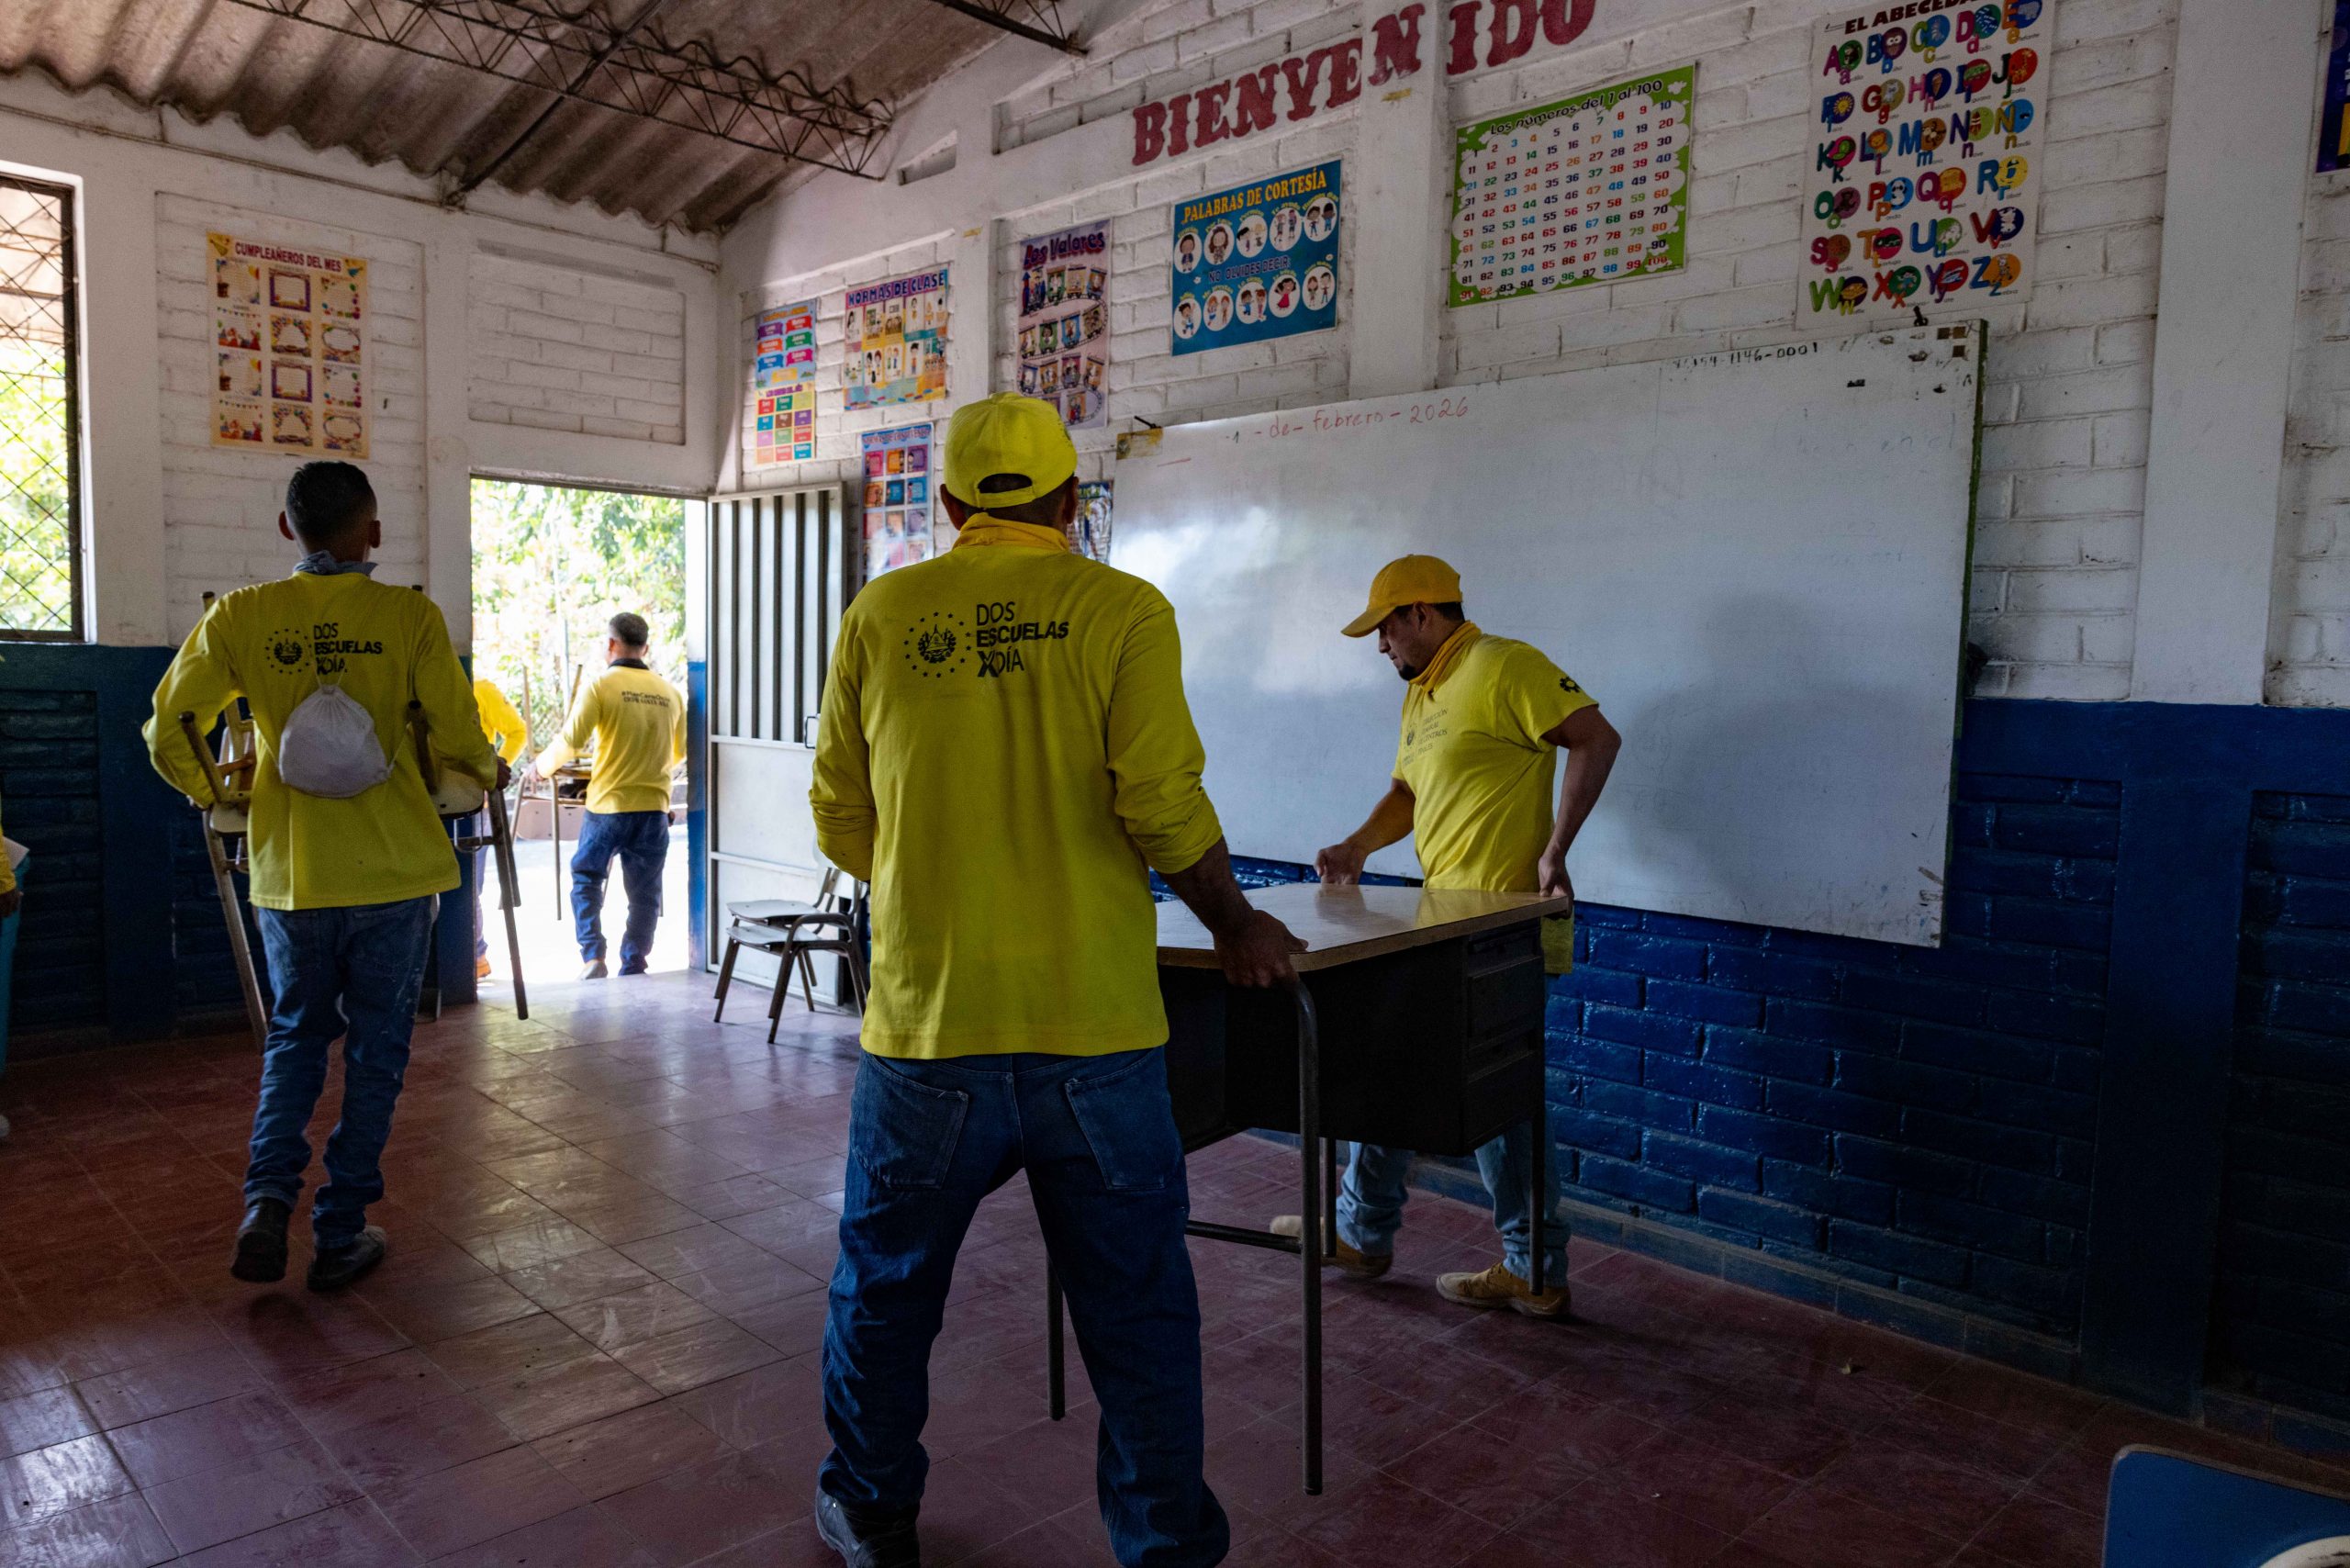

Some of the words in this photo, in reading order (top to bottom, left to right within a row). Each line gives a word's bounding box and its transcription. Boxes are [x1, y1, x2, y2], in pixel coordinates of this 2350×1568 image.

[1845, 17, 1868, 34] EL
[1491, 123, 1512, 134] Los
[1516, 106, 1577, 127] números
[1582, 95, 1604, 109] del
[1608, 93, 1614, 104] 1
[1618, 88, 1630, 101] al
[1637, 80, 1662, 95] 100
[1492, 144, 1498, 152] 2
[1553, 128, 1561, 137] 5
[1572, 122, 1579, 131] 6
[1597, 117, 1604, 125] 7
[1617, 111, 1624, 120] 8
[1639, 106, 1647, 115] 9
[1660, 100, 1672, 110] 10
[1468, 165, 1476, 174] 11
[1486, 161, 1496, 171] 12
[1506, 156, 1516, 165] 13
[1527, 151, 1537, 160] 14
[1547, 145, 1558, 154] 15
[1568, 140, 1579, 150] 16
[1592, 135, 1601, 144] 17
[1613, 129, 1624, 139] 18
[1636, 123, 1648, 133] 19
[1659, 118, 1673, 129] 20
[1484, 176, 1497, 186] 22
[1504, 172, 1517, 182] 23
[1525, 166, 1538, 177] 24
[1545, 162, 1559, 172] 25
[1589, 151, 1604, 162] 27
[1610, 147, 1625, 158] 28
[1633, 141, 1648, 152] 29
[1657, 136, 1672, 147] 30
[1181, 192, 1244, 224] PALABRAS
[1247, 187, 1262, 207] DE
[1265, 167, 1326, 201] CORTESÍA
[1464, 213, 1474, 221] 41
[1482, 208, 1495, 218] 42
[1503, 204, 1516, 213] 43
[1523, 199, 1537, 208] 44
[1544, 195, 1558, 205] 45
[1564, 190, 1578, 200] 46
[1608, 181, 1623, 191] 48
[1631, 175, 1647, 185] 49
[1654, 170, 1670, 181] 50
[1465, 197, 1475, 207] 31
[1483, 192, 1496, 202] 32
[1546, 178, 1559, 188] 35
[1566, 174, 1579, 184] 36
[1588, 168, 1603, 178] 37
[1609, 163, 1624, 174] 38
[1633, 158, 1648, 169] 39
[1656, 153, 1672, 163] 40
[1463, 229, 1473, 238] 51
[1483, 224, 1495, 234] 52
[1503, 220, 1515, 230] 53
[1522, 216, 1535, 226] 54
[1543, 211, 1557, 221] 55
[1564, 207, 1578, 217] 56
[1586, 202, 1601, 212] 57
[1607, 198, 1622, 208] 58
[1502, 236, 1515, 246] 63
[1521, 231, 1534, 241] 64
[1542, 228, 1556, 237] 65
[1563, 223, 1577, 233] 66
[1585, 218, 1599, 229] 67
[1606, 214, 1621, 224] 68
[1629, 209, 1644, 220] 69
[1653, 205, 1668, 215] 70
[235, 242, 305, 265] CUMPLEAÑEROS
[307, 255, 322, 268] DEL
[324, 259, 341, 272] MES
[1024, 244, 1048, 270] Los
[1050, 231, 1105, 261] Valores
[1462, 275, 1472, 284] 81
[1480, 271, 1494, 281] 82
[1501, 267, 1514, 277] 83
[1521, 263, 1534, 274] 84
[1542, 260, 1555, 270] 85
[1561, 255, 1575, 265] 86
[1583, 252, 1596, 262] 87
[1651, 240, 1666, 249] 90
[1463, 259, 1472, 269] 71
[1502, 252, 1515, 262] 73
[1521, 247, 1535, 257] 74
[1543, 243, 1556, 253] 75
[1563, 240, 1577, 250] 76
[1585, 235, 1598, 245] 77
[1606, 230, 1621, 241] 78
[849, 286, 891, 306] NORMAS
[894, 282, 908, 296] DE
[912, 273, 944, 292] CLASE
[1209, 270, 1221, 283] NO
[1500, 284, 1514, 292] 93
[1520, 280, 1534, 288] 94
[1541, 275, 1555, 286] 95
[1627, 260, 1640, 269] 99
[1410, 398, 1468, 424] 2026
[314, 622, 339, 640] DOS
[977, 601, 1015, 626] DOS
[315, 641, 383, 655] ESCUELAS
[977, 622, 1069, 647] ESCUELAS
